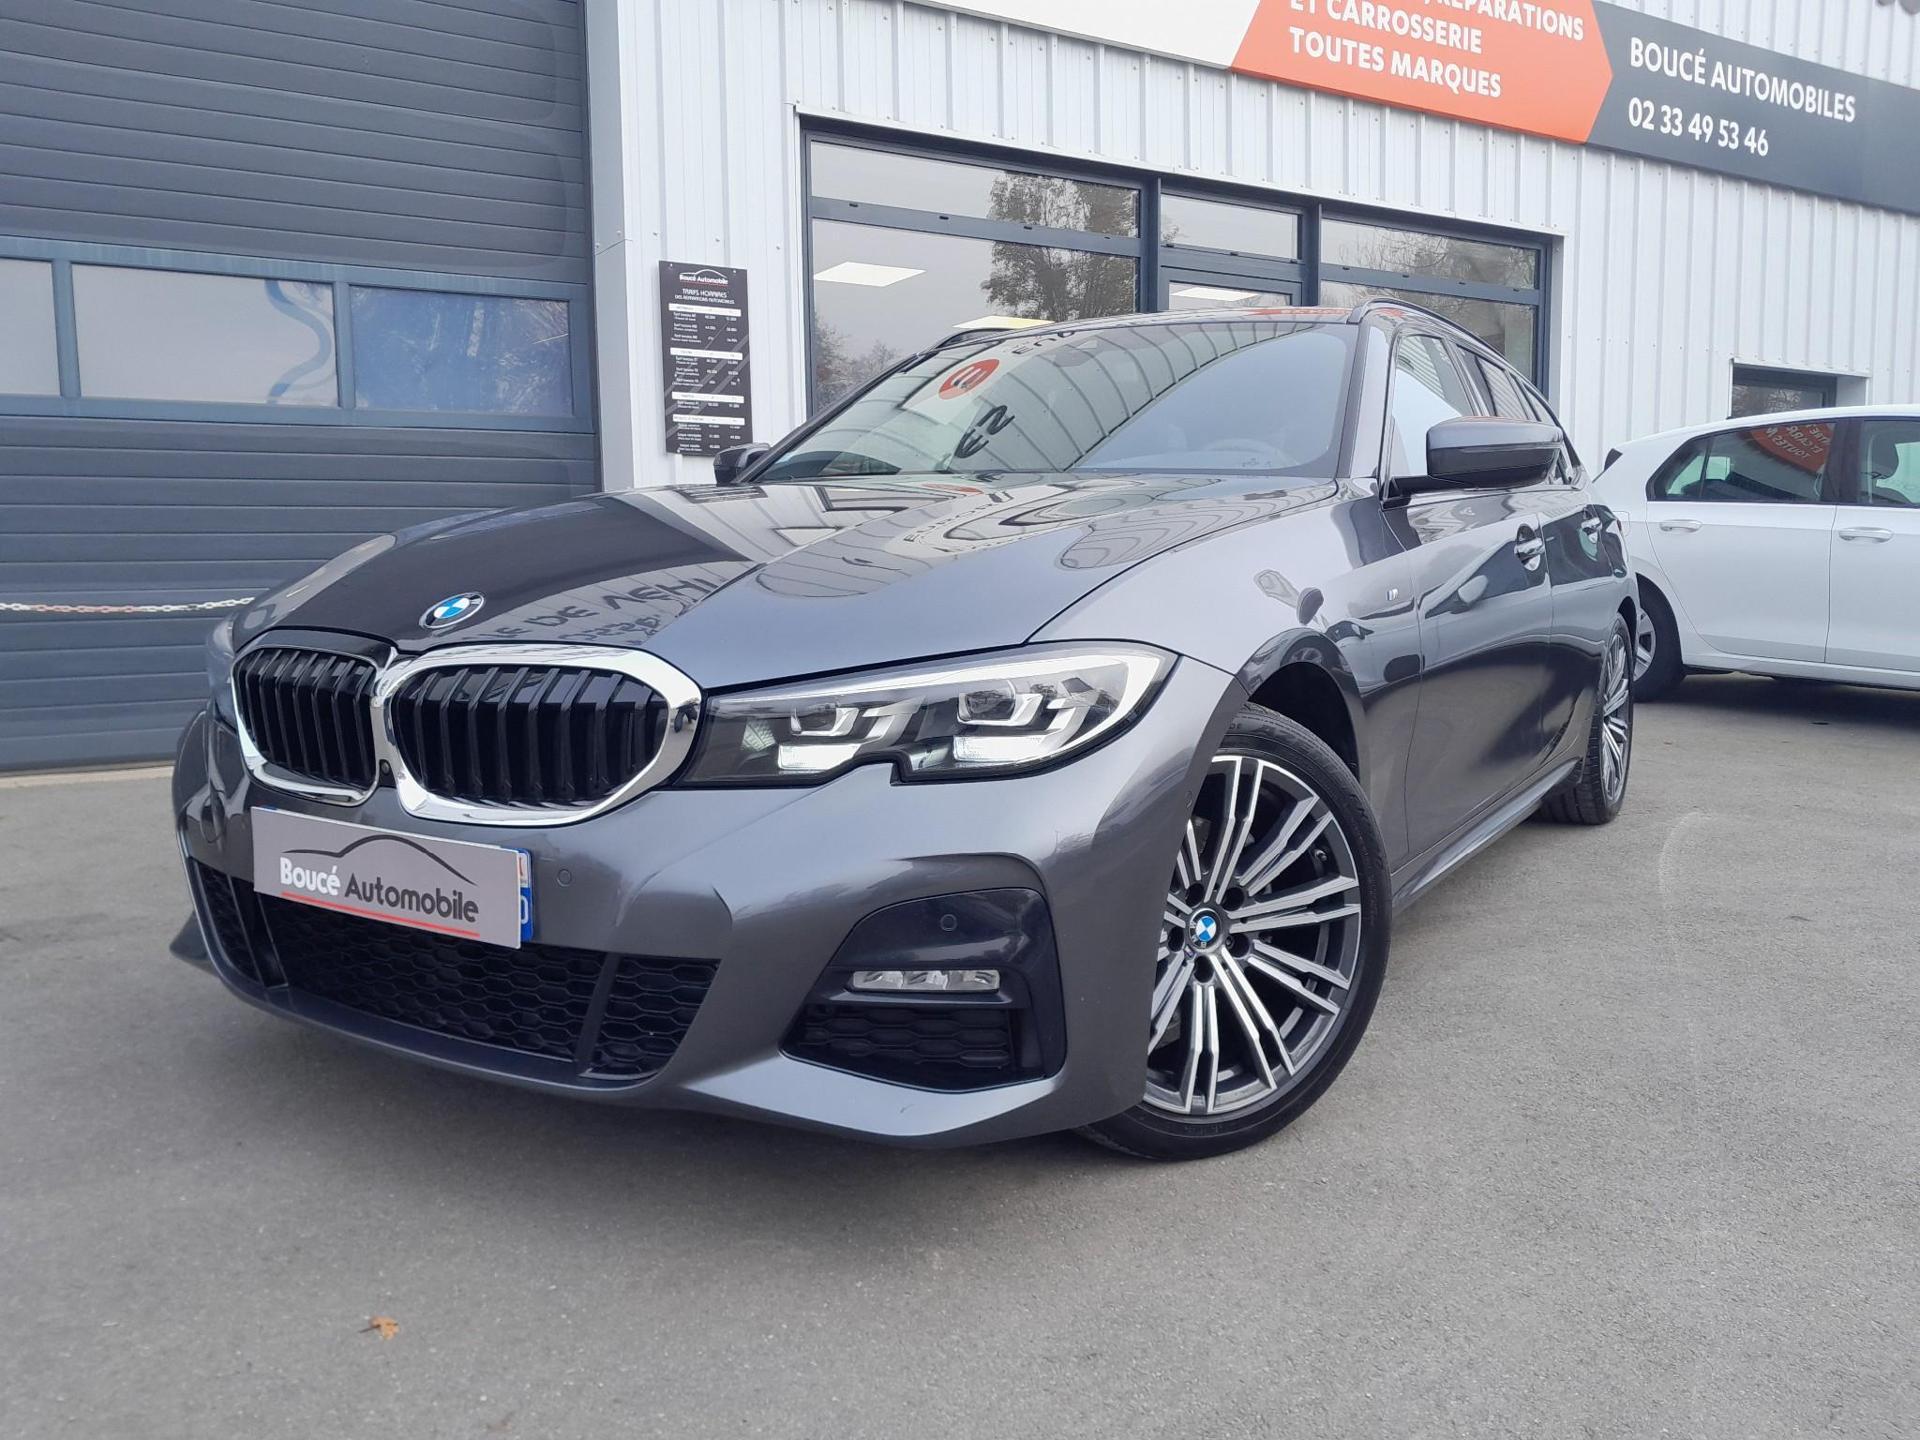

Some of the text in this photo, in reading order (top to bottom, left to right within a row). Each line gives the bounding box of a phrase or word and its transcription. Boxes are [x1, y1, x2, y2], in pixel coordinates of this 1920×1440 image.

[1326, 0, 1482, 54] CARROSSERIE
[1439, 0, 1584, 41] ARATIONS
[1289, 26, 1502, 98] TOUTES MARQUES
[1630, 36, 1857, 123] BOUCÉ AUTOMOBILES
[1628, 97, 1769, 157] 02 33 49 53 46
[279, 857, 480, 923] Boucé Automobile
